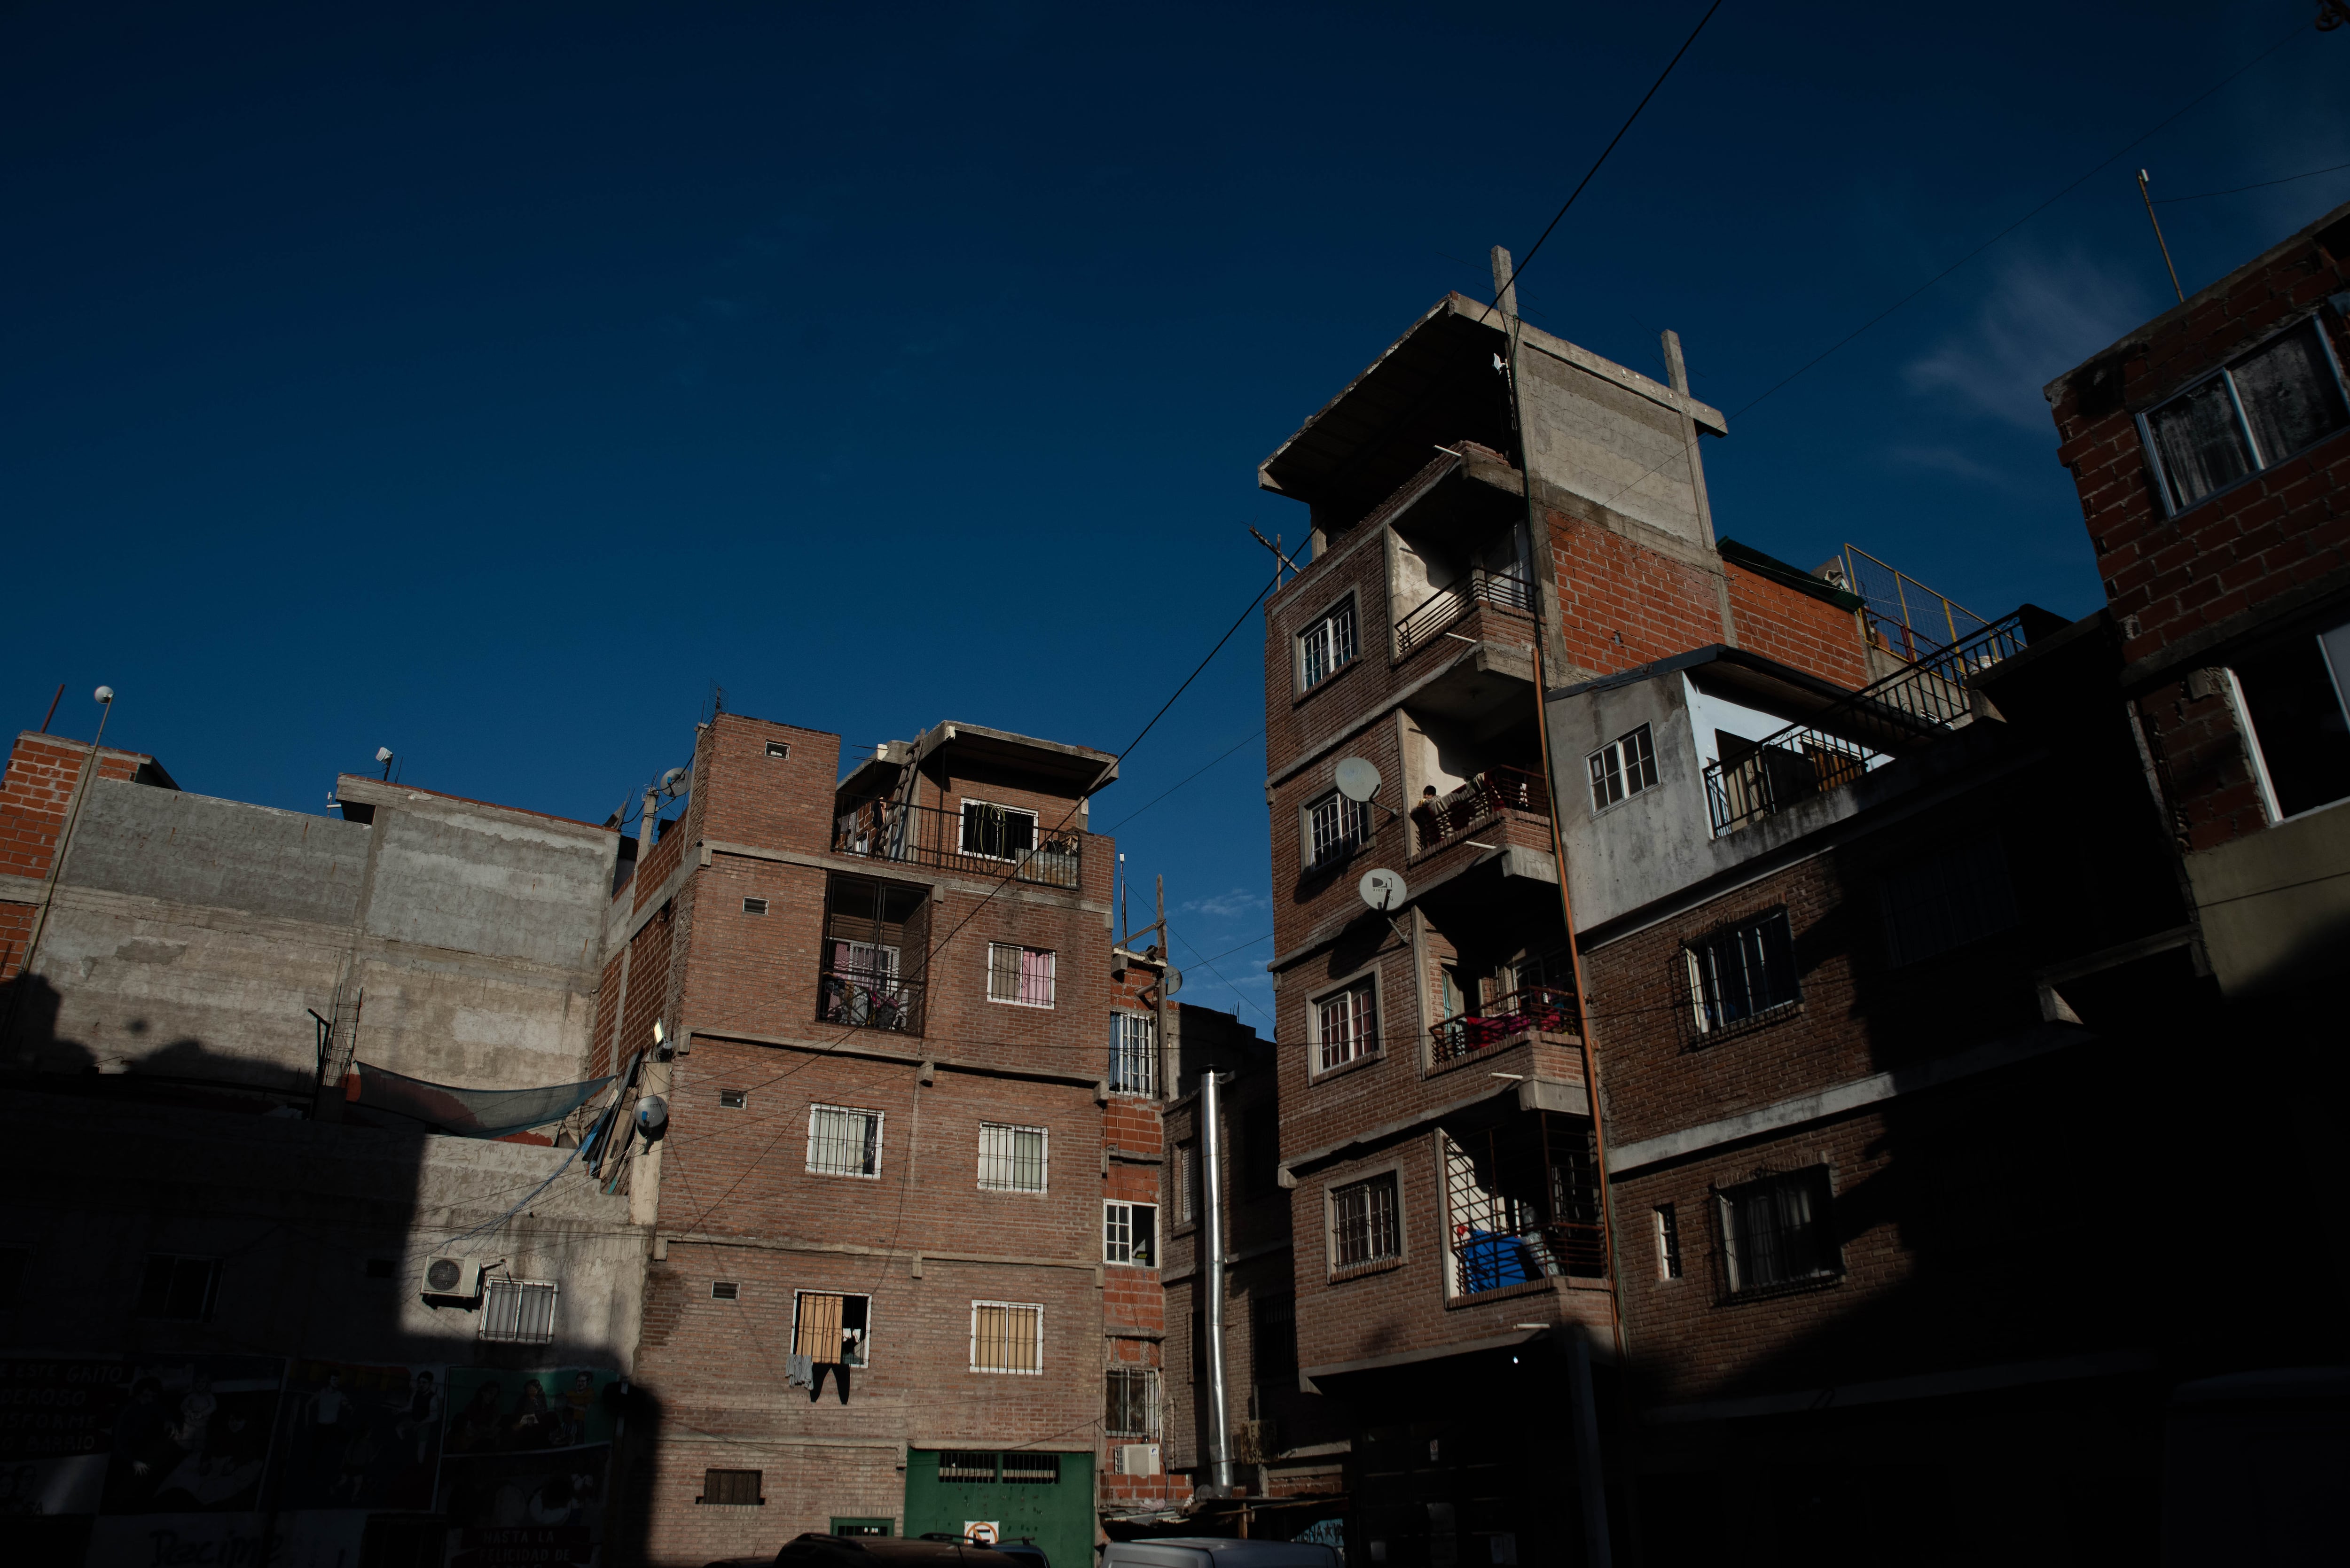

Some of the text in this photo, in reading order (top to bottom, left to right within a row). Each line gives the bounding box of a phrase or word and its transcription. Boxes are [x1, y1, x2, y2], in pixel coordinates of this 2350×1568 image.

[16, 1363, 58, 1378] ESTE
[66, 1363, 123, 1383] GRITO
[26, 1431, 95, 1452] BARRIO
[482, 1529, 554, 1544] HASTA LA
[478, 1548, 571, 1564] FELICIDAD DE
